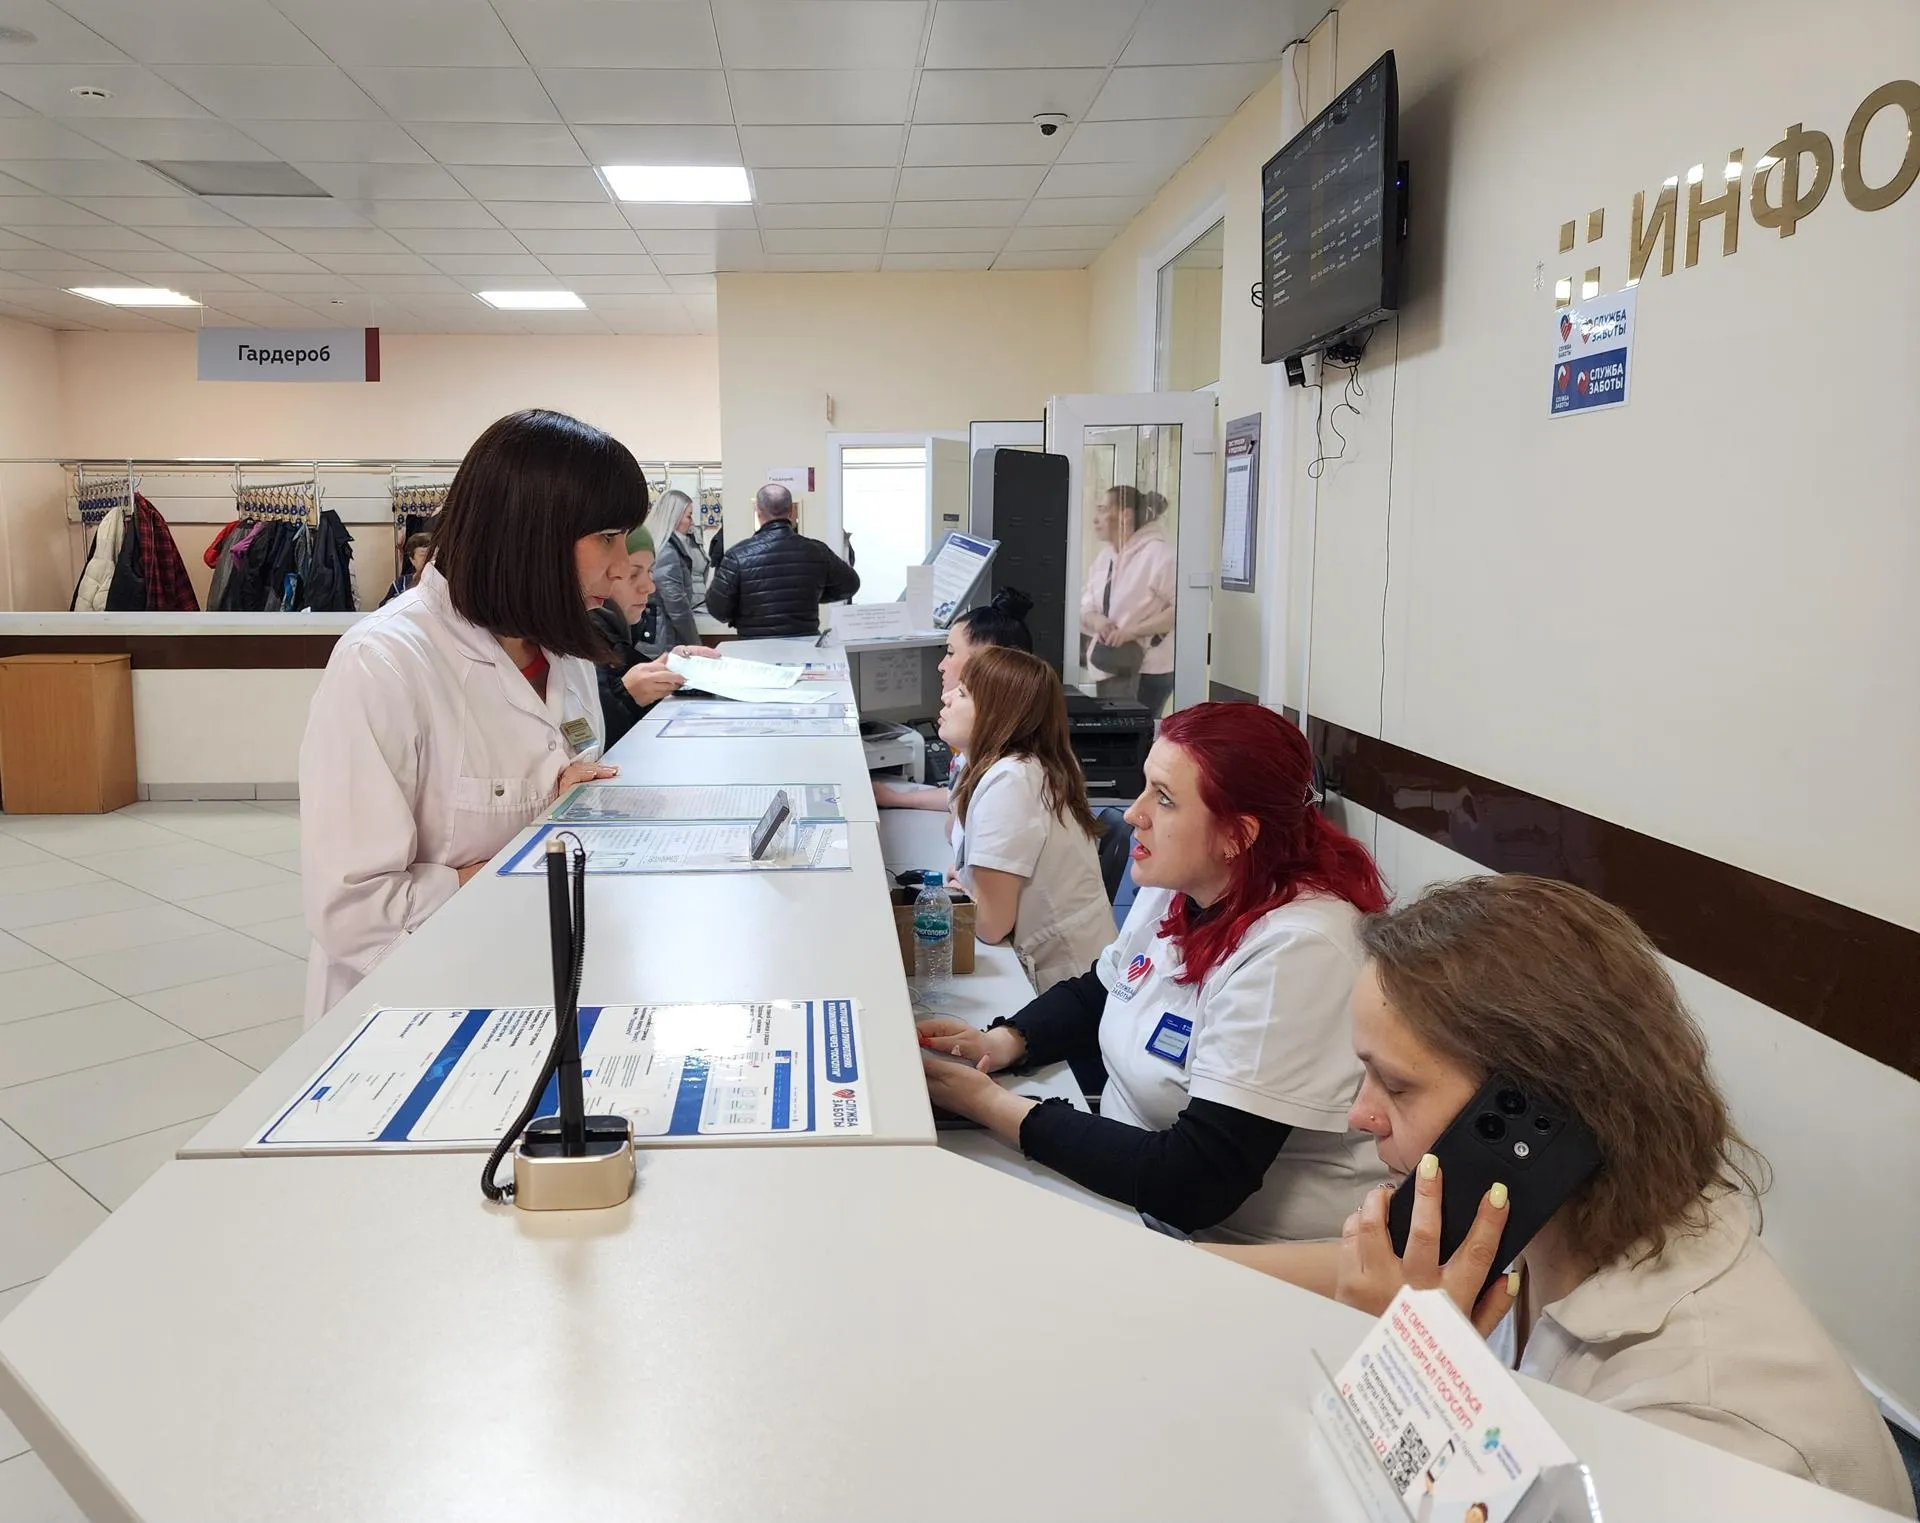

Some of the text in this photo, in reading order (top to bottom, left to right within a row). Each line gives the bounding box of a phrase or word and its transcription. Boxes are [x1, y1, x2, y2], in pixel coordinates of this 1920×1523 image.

[1626, 79, 1920, 282] ИНФО
[238, 345, 331, 366] Гардероб
[1590, 363, 1623, 380] СЛУЖБА
[1589, 378, 1623, 394] ЗАБОТЫ
[1111, 987, 1132, 1001] ЗАБОТЫ
[1115, 981, 1135, 995] СЛУЖБА
[833, 1099, 844, 1128] ЗАБОТЫ
[845, 1099, 858, 1127] СЛУЖБА
[1392, 1312, 1411, 1341] ЧЕРЕЗ
[1409, 1338, 1437, 1379] ПОРТАЛ
[1400, 1301, 1484, 1415] НЕ СМОГЛИ ЗАПИСАТЬСЯ
